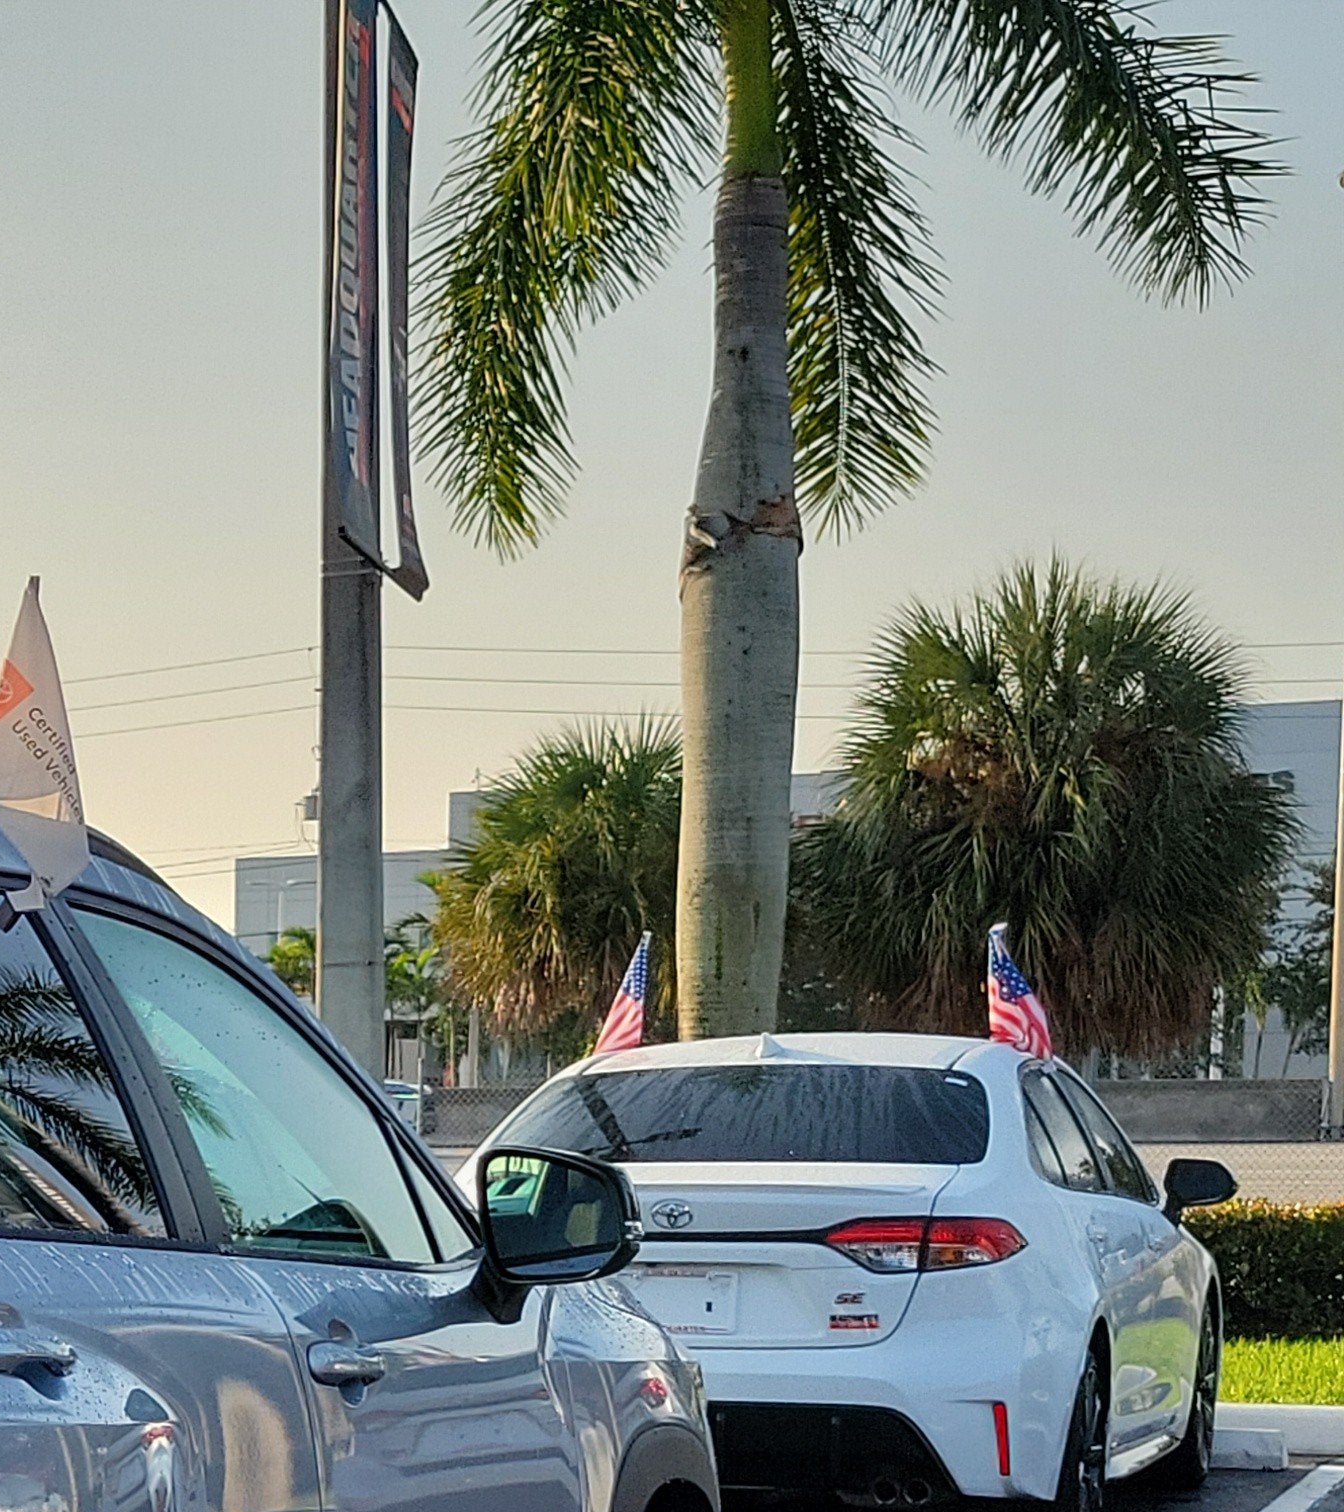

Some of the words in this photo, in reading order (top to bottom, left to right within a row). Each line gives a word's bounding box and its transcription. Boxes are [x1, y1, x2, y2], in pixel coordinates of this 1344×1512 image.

[12, 720, 47, 760] Used
[28, 707, 76, 775] Certified
[834, 1292, 865, 1304] SE
